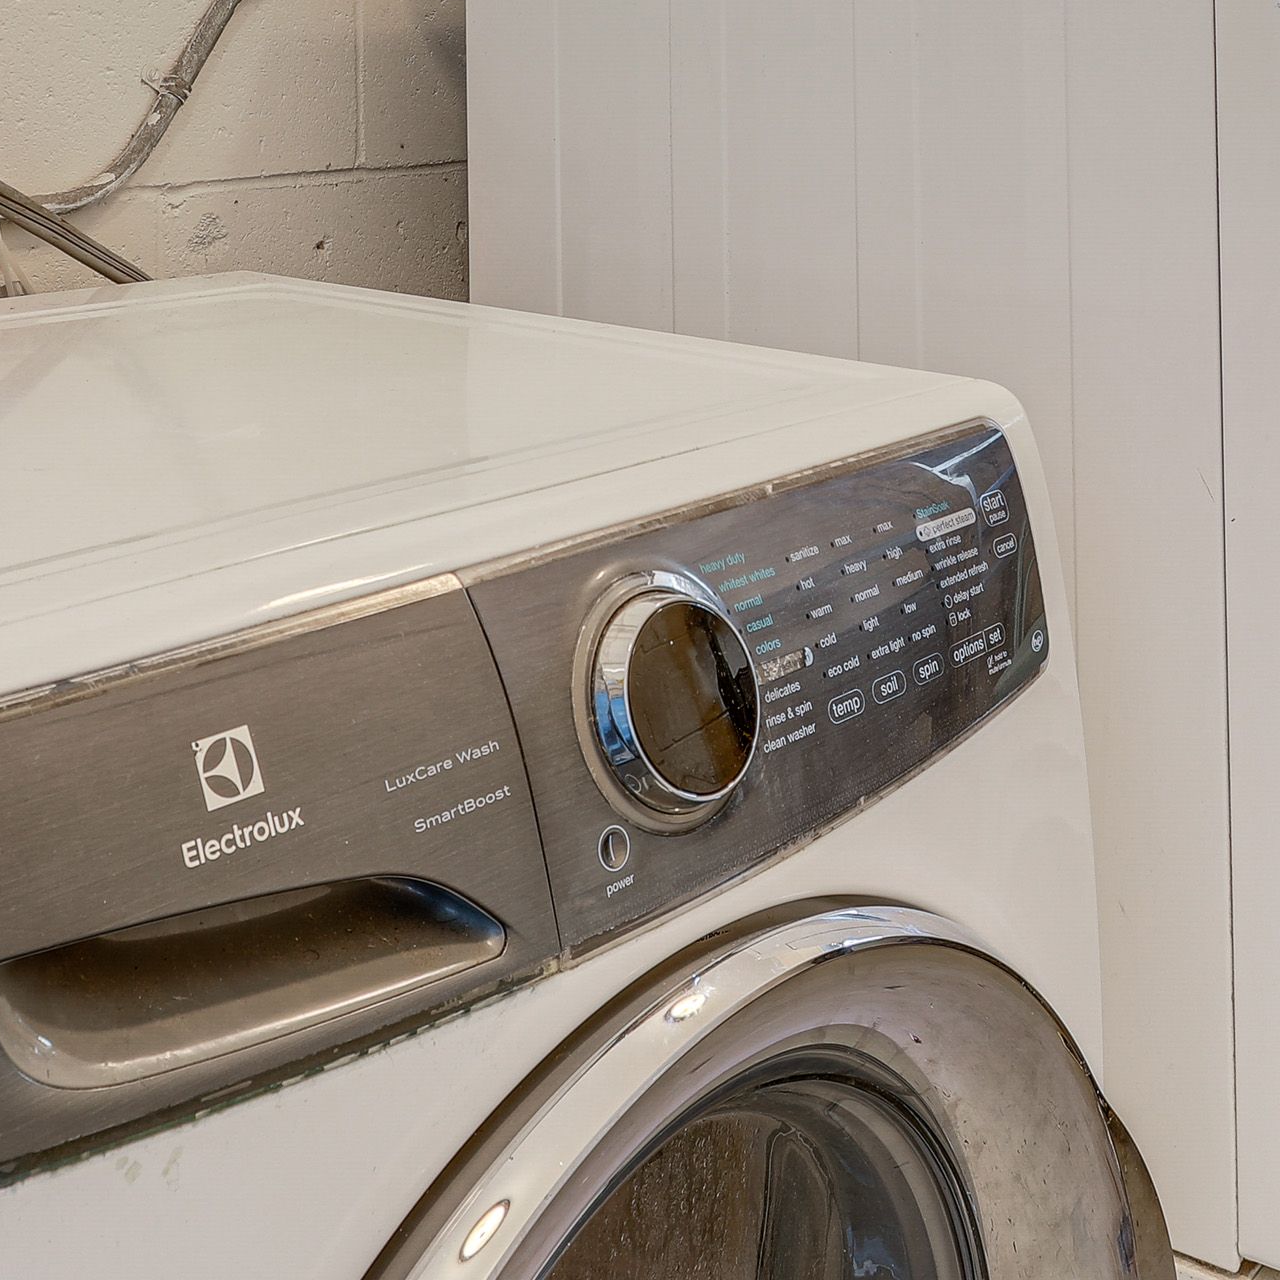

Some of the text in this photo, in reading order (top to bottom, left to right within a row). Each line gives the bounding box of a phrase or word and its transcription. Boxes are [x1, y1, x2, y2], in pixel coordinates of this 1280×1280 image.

[983, 493, 1005, 512] start
[989, 510, 1007, 524] pause
[876, 521, 894, 533] max
[932, 519, 956, 535] perfect
[834, 535, 853, 547] max
[928, 534, 962, 554] extra rinse
[996, 537, 1015, 553] cancel
[789, 545, 820, 562] sanitize
[885, 546, 904, 561] high
[934, 546, 979, 571] wrinkle release
[843, 559, 868, 575] heavy
[939, 561, 990, 589] extended refresh
[799, 577, 816, 591] hot
[895, 568, 924, 587] medium
[733, 593, 764, 612] normal
[854, 584, 881, 603] normal
[952, 582, 985, 605] delay start
[809, 603, 833, 619] warm
[903, 602, 918, 615] low
[956, 607, 972, 622] lock
[746, 614, 775, 633] casual
[862, 615, 881, 632] light
[911, 623, 937, 642] no spin
[755, 638, 782, 655] colors
[819, 632, 838, 649] cold
[871, 636, 906, 660] extra light
[953, 627, 1002, 664] options set
[827, 655, 860, 678] eco cold
[918, 659, 940, 680] spin
[764, 681, 801, 704] delicates
[880, 675, 899, 697] soil
[765, 700, 813, 729] rinse & spin
[832, 696, 861, 718] temp
[763, 723, 817, 754] clean washer
[384, 740, 501, 793] LuxCare Wash
[414, 785, 512, 833] SmartBoost
[181, 807, 305, 869] Electrolux
[606, 873, 635, 898] power
